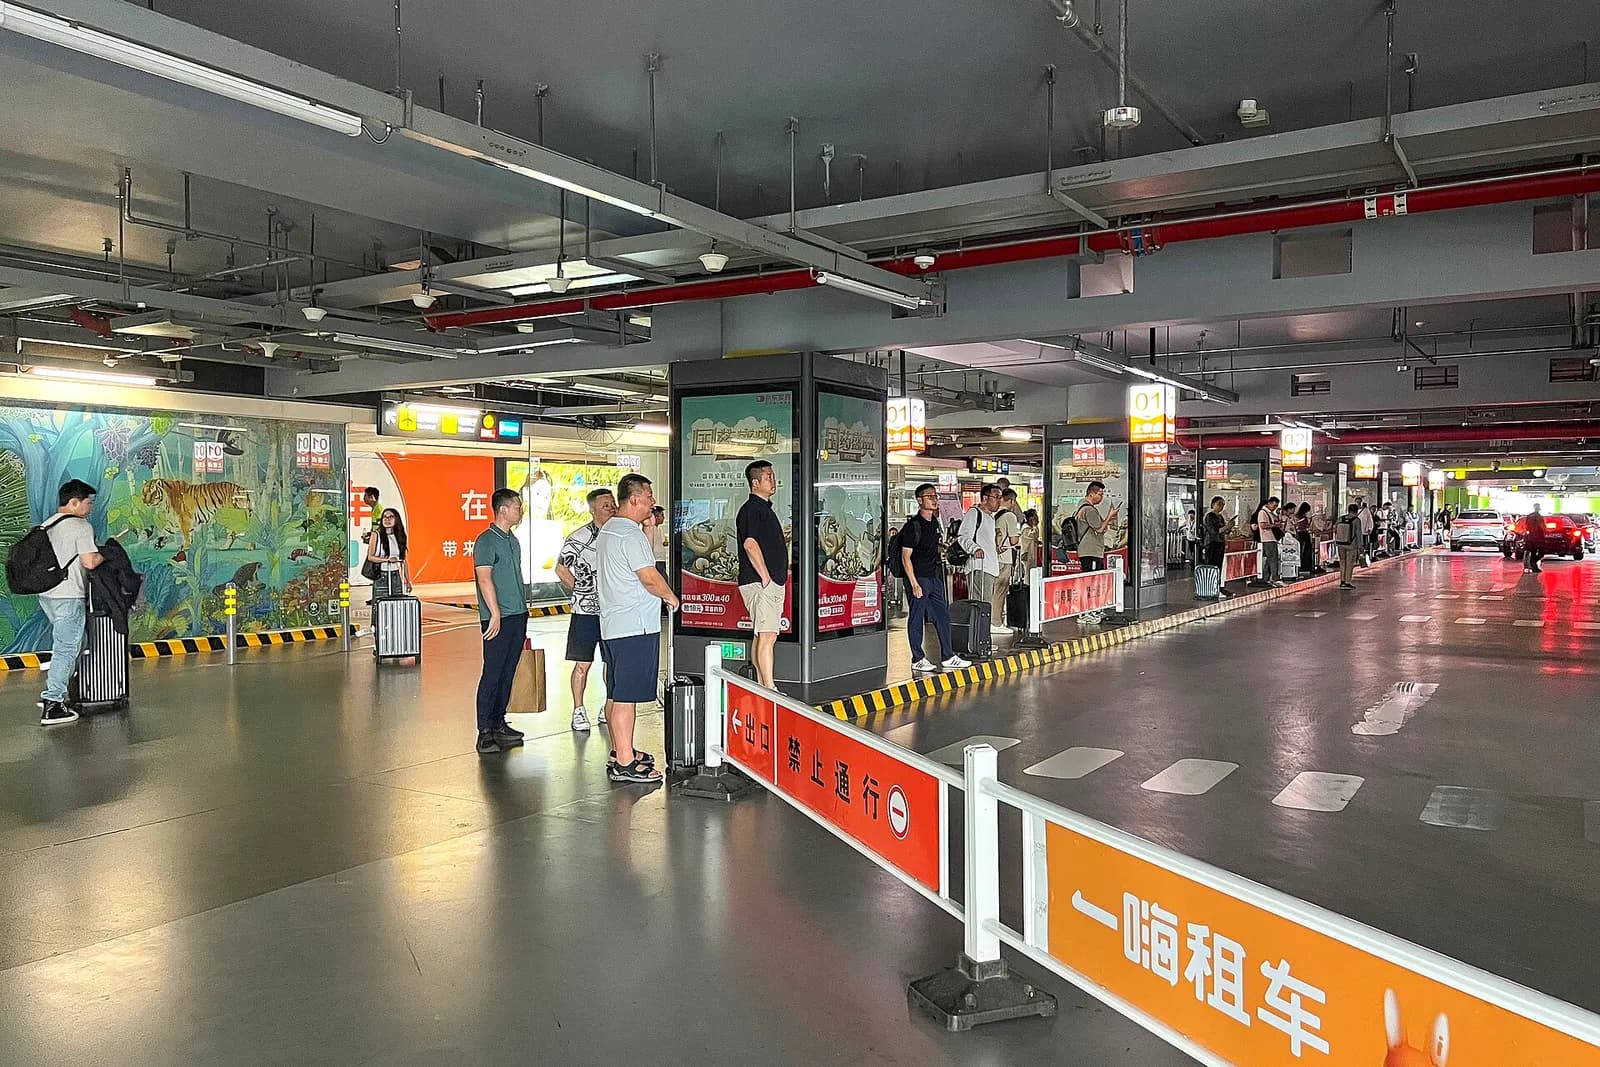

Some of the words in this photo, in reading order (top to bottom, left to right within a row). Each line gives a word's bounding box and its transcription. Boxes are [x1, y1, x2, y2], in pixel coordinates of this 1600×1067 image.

[887, 405, 907, 423] 01
[1135, 391, 1161, 410] 01
[461, 489, 488, 520] 在
[745, 713, 769, 752] 出口
[788, 735, 880, 820] 禁止通行
[1071, 889, 1330, 1057] 一嗨租车
